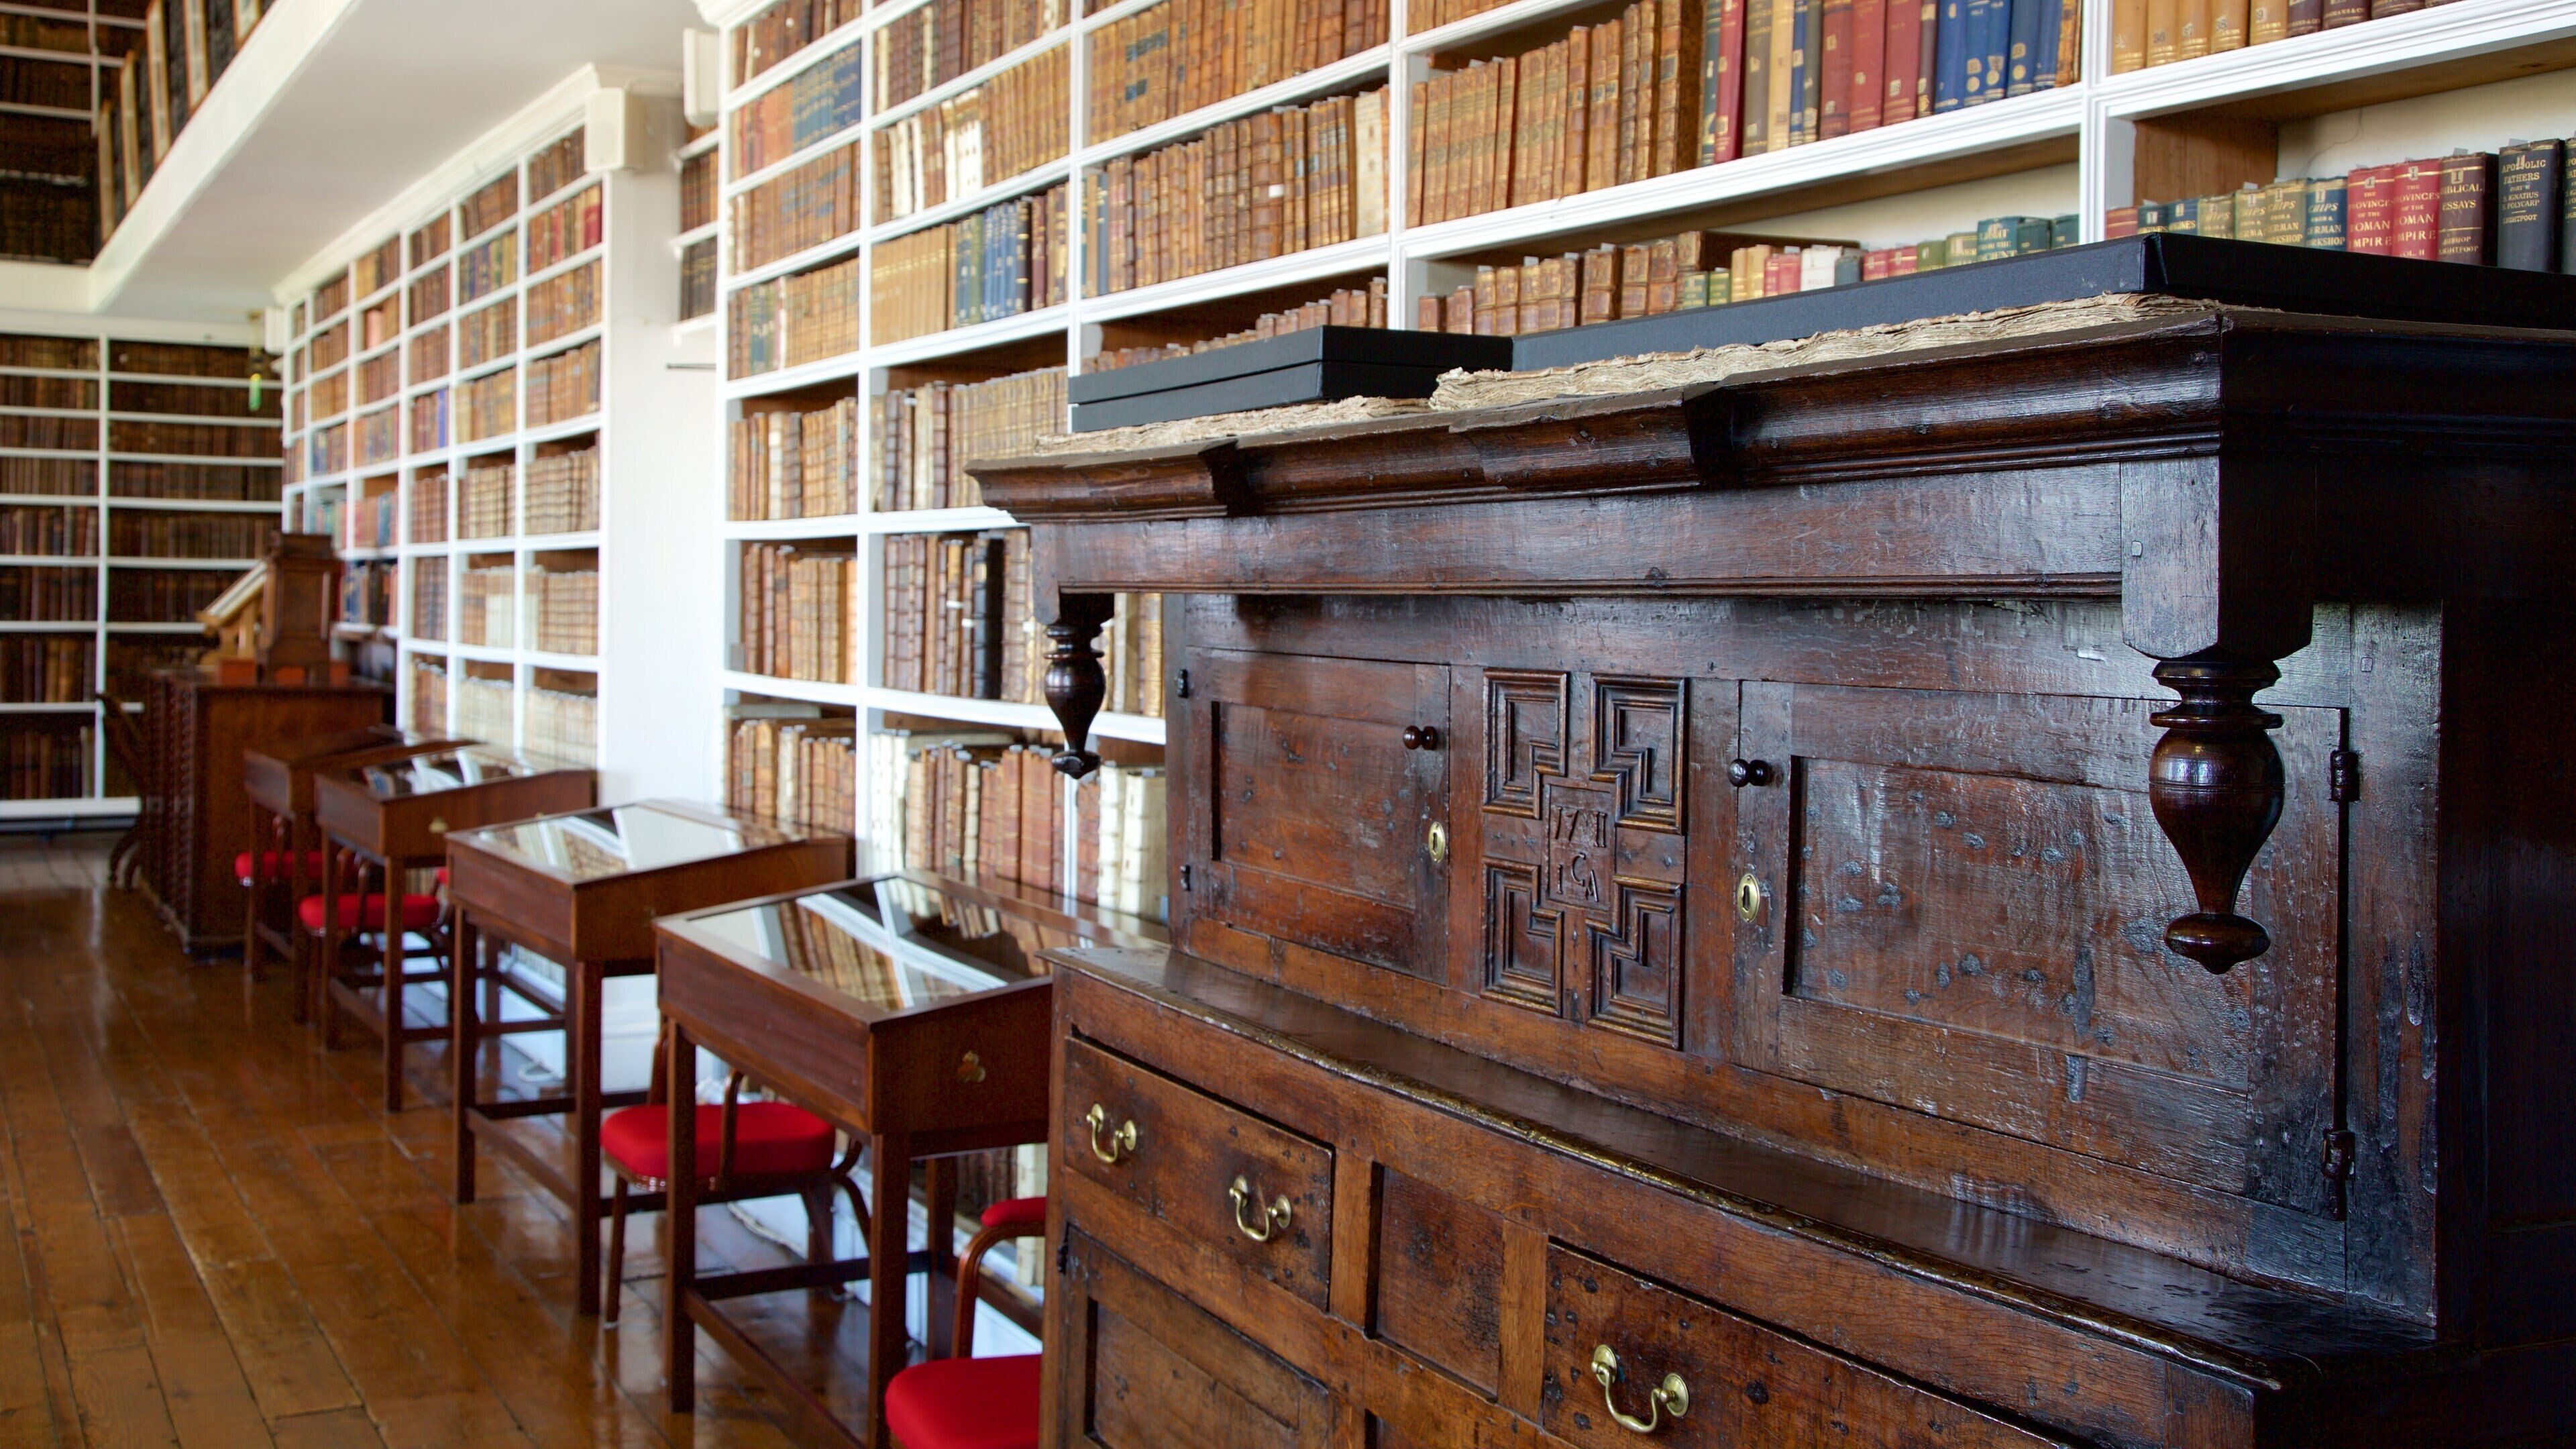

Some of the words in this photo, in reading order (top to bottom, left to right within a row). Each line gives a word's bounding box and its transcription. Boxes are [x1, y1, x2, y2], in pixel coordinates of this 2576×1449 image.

[2504, 172, 2540, 184] FATHERS
[2394, 192, 2440, 203] OVINCES
[2508, 191, 2538, 201] IGNATIUS
[2443, 199, 2476, 211] ESSAYS
[2508, 199, 2540, 209] POLYCARP
[2503, 214, 2538, 224] LIGHTFOOT
[2266, 222, 2299, 233] RMAN
[2267, 233, 2303, 244] RKSHOP
[2307, 236, 2345, 247] RKSHOP
[2395, 230, 2436, 242] MPIRE
[2443, 235, 2471, 246] BISHOP
[2439, 245, 2479, 255] LIGHTFOOT
